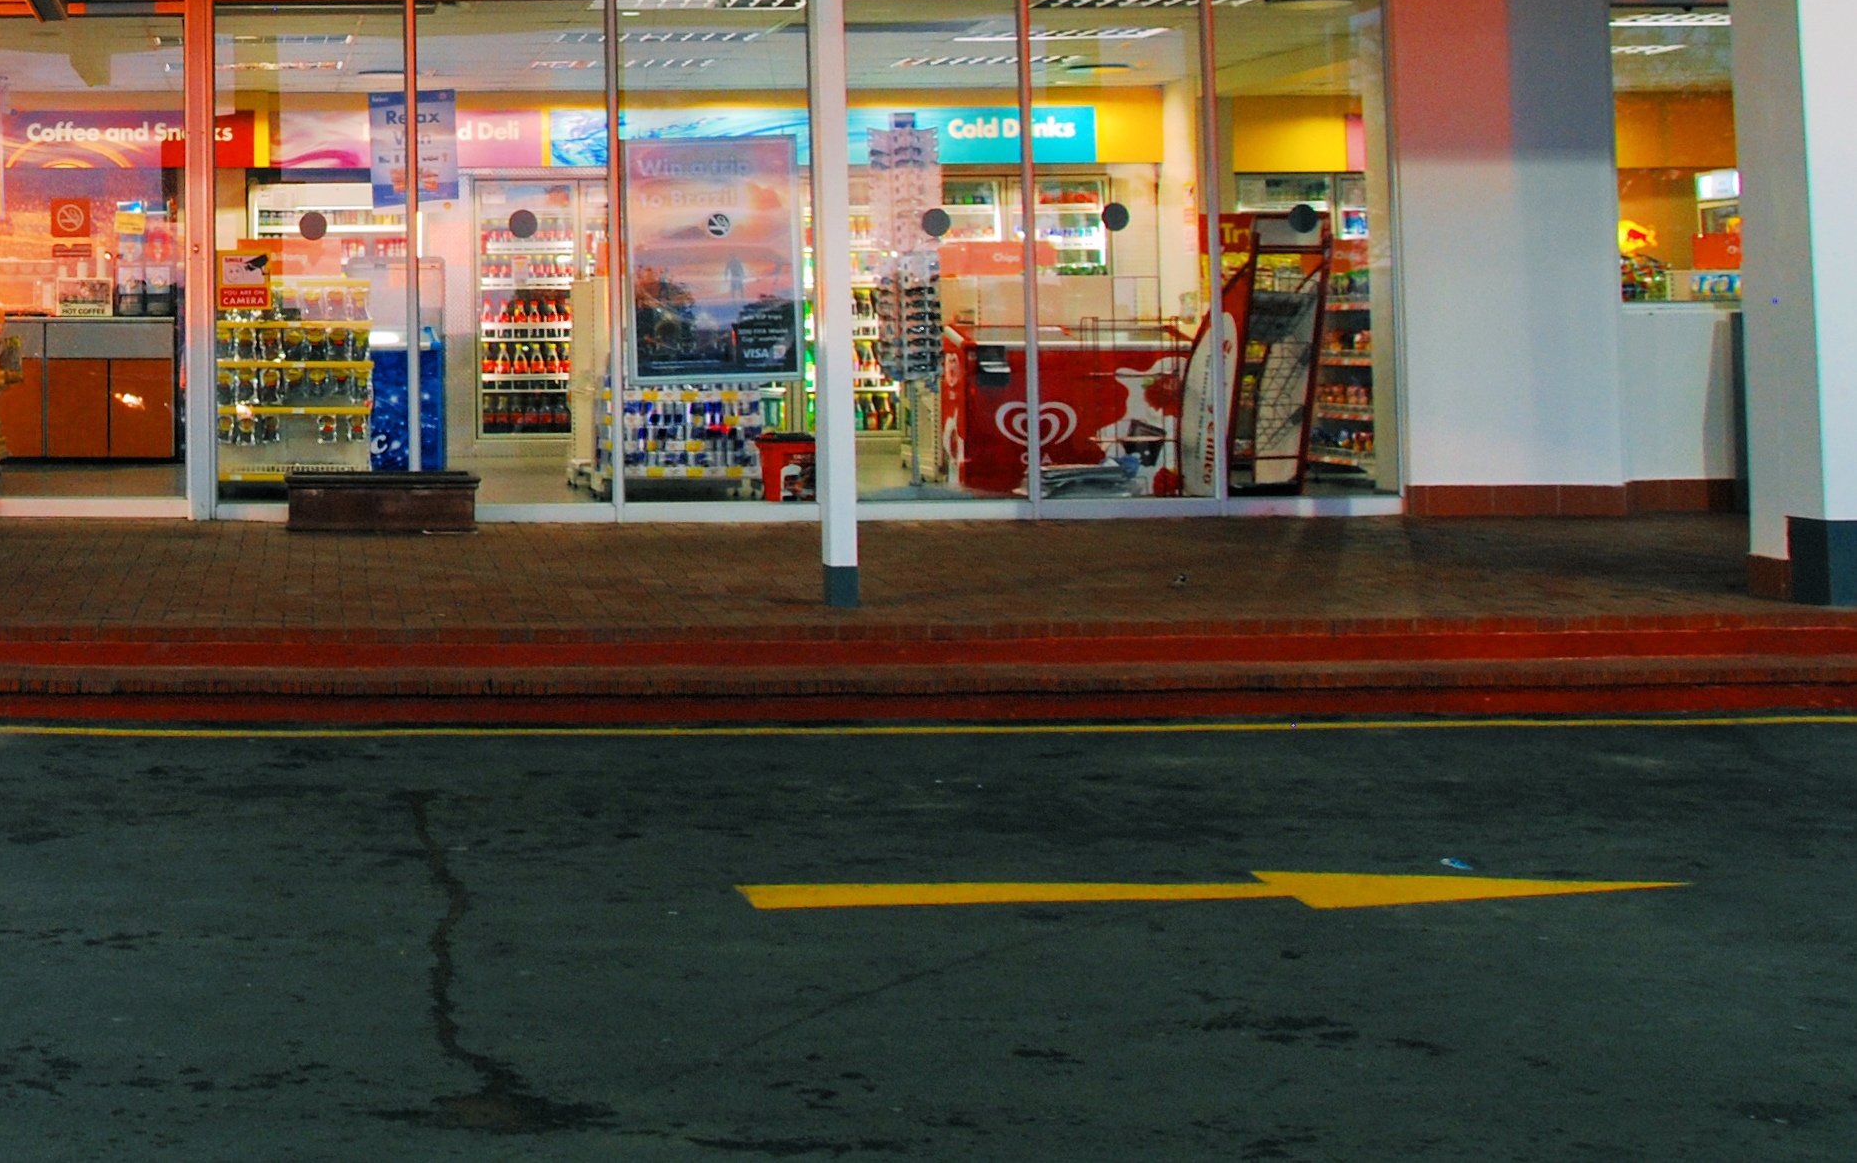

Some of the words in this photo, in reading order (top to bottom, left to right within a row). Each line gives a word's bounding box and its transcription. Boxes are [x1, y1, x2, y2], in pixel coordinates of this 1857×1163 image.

[385, 110, 441, 125] Reax
[26, 121, 99, 142] Coffee
[105, 122, 149, 141] and
[154, 123, 233, 142] Snks
[478, 120, 521, 141] Deli
[948, 117, 999, 139] Cold
[1002, 116, 1076, 138] Dnks
[223, 297, 264, 305] CAMERA
[743, 349, 769, 359] VISA
[1020, 453, 1053, 465] OA
